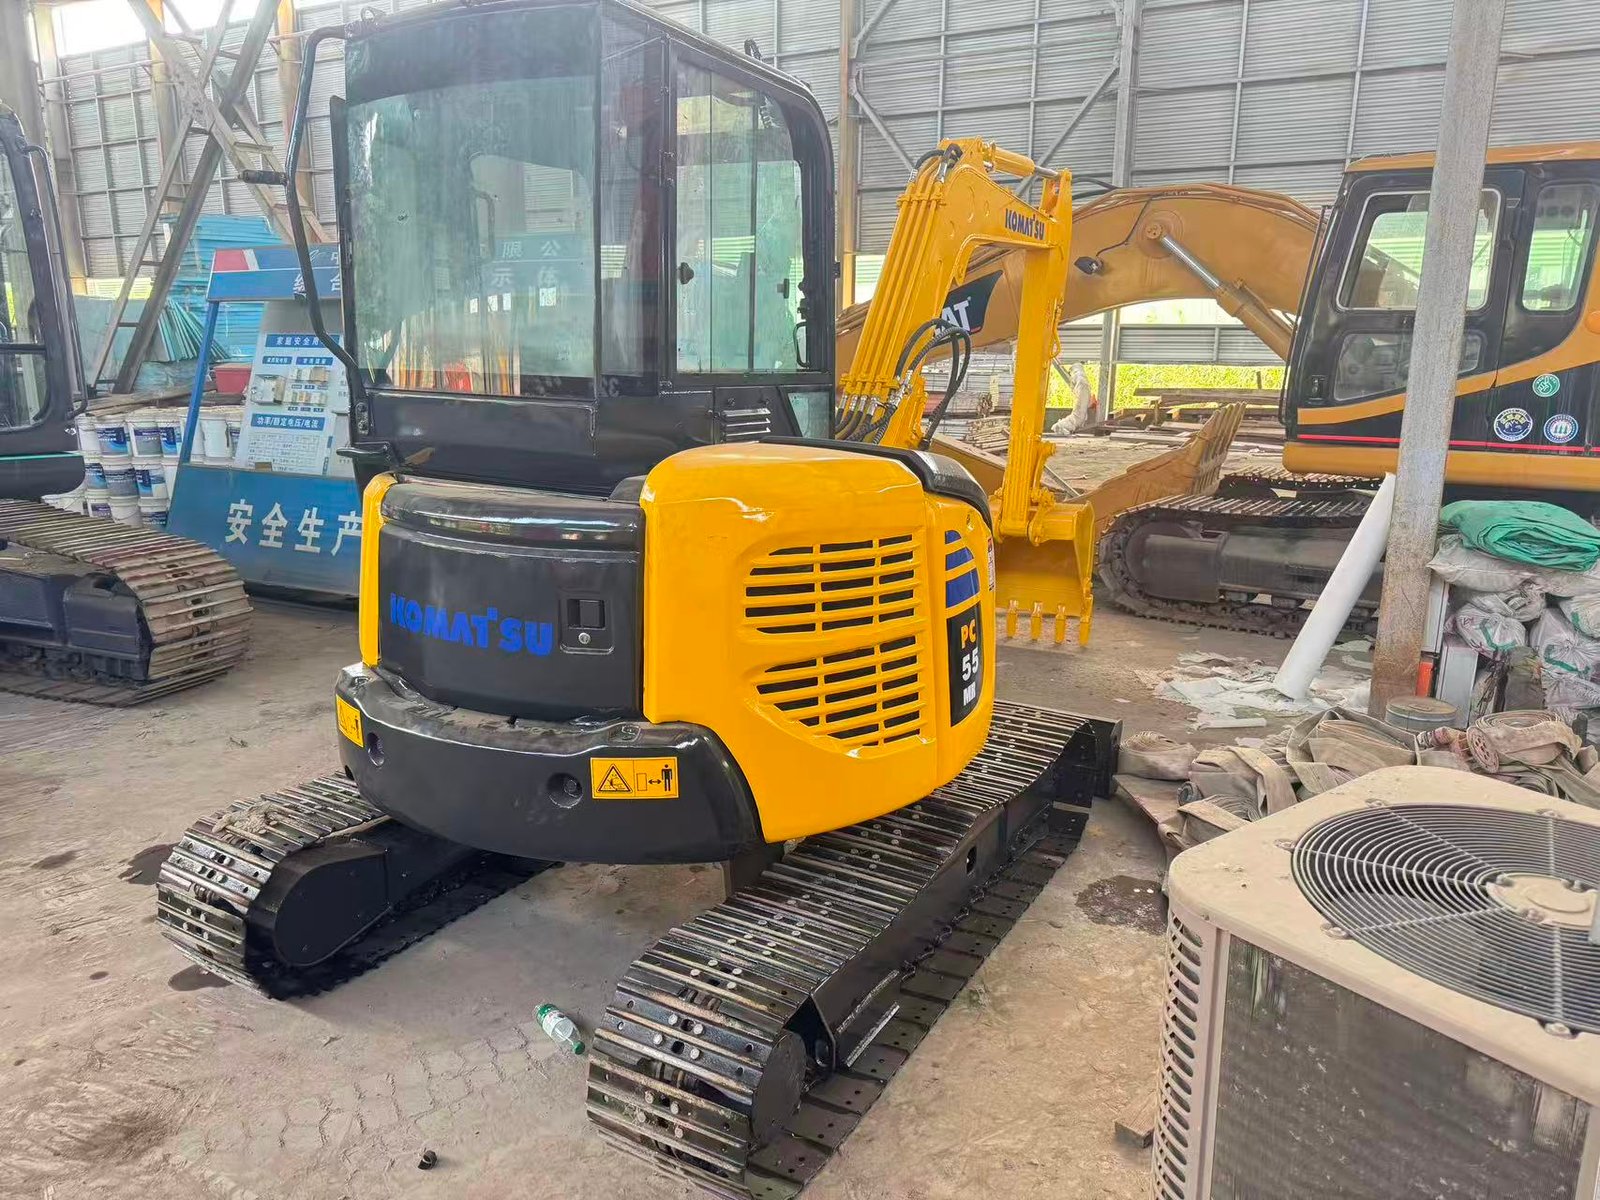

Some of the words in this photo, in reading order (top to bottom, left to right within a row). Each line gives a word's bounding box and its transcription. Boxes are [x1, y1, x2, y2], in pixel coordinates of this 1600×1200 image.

[1005, 208, 1045, 241] KOMATSU
[935, 299, 971, 335] AT
[225, 498, 362, 556] 安全生产
[390, 592, 554, 657] KOMATSU
[960, 618, 977, 649] PC
[961, 647, 979, 681] 55
